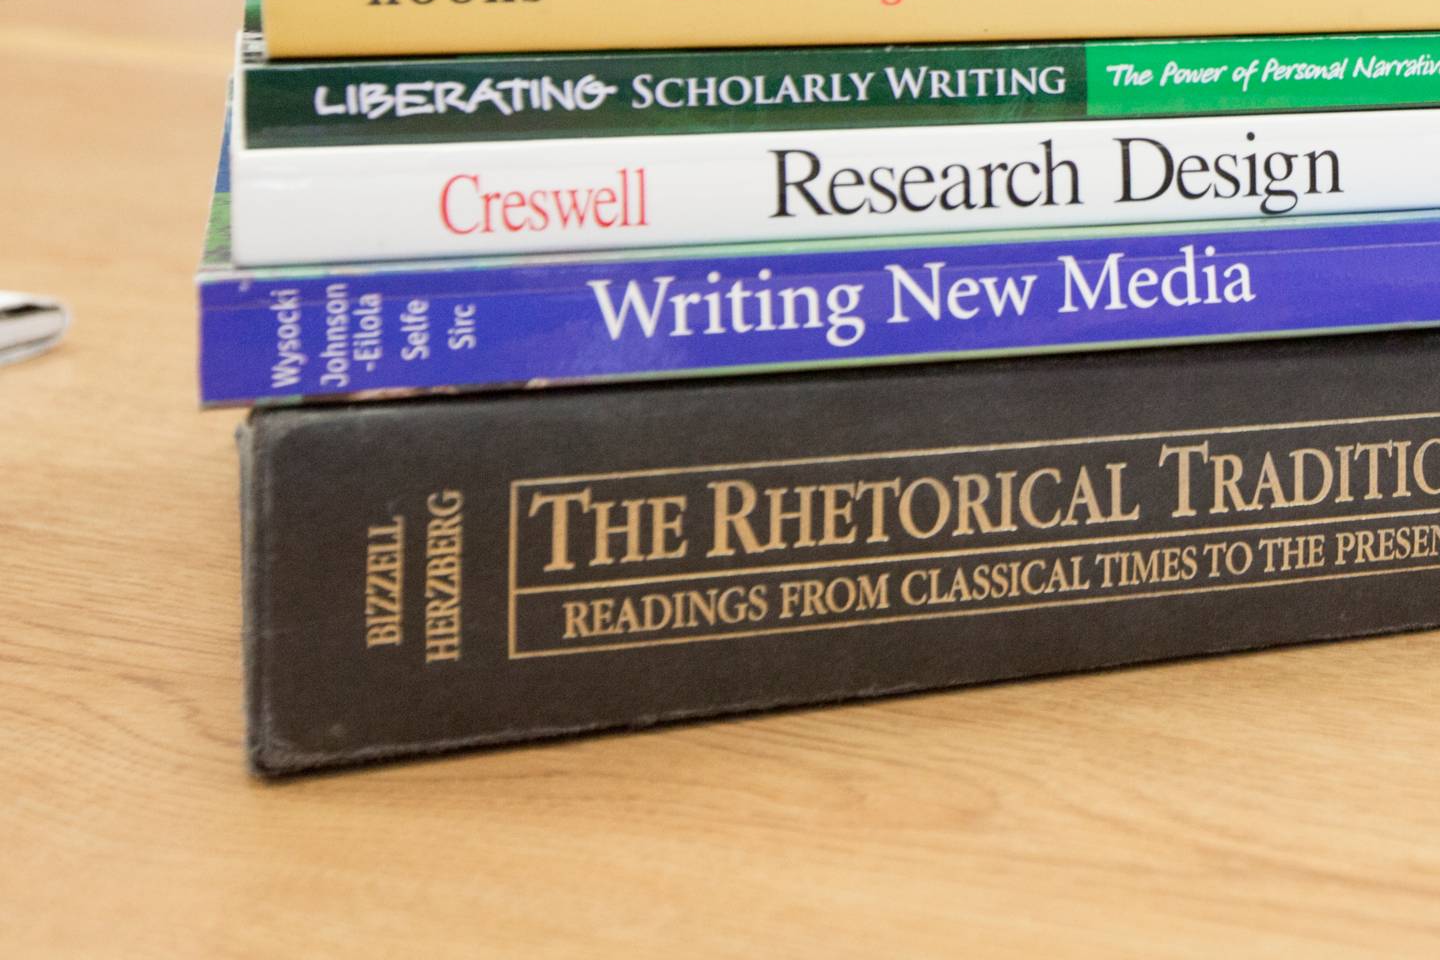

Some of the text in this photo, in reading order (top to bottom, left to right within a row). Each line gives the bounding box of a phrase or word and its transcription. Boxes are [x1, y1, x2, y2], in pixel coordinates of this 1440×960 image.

[314, 66, 1066, 119] LIBERATING SCHOLARLY WRITING
[1106, 63, 1153, 87] The
[1159, 64, 1226, 87] Power
[1232, 60, 1259, 92] of
[1262, 58, 1346, 83] Personal
[440, 168, 649, 237] Creswell
[769, 131, 1344, 219] Research Design
[270, 288, 309, 389] Wysocki
[319, 283, 350, 388] Johnson
[353, 293, 383, 372] -Eilola
[400, 299, 430, 361] Selfe
[448, 303, 477, 350] Sirc
[589, 246, 1256, 347] Writing New Media
[528, 487, 689, 573] THE
[706, 463, 1139, 559] RHETORICAL
[367, 515, 405, 648] BIZZELL
[426, 489, 463, 664] HERZBERG
[562, 586, 768, 639] READINGS
[779, 574, 891, 619] FROM
[901, 556, 1089, 607] CLASSICAL
[1095, 547, 1198, 588] TIMES
[1203, 542, 1252, 576] TO
[1259, 536, 1325, 574] THE
